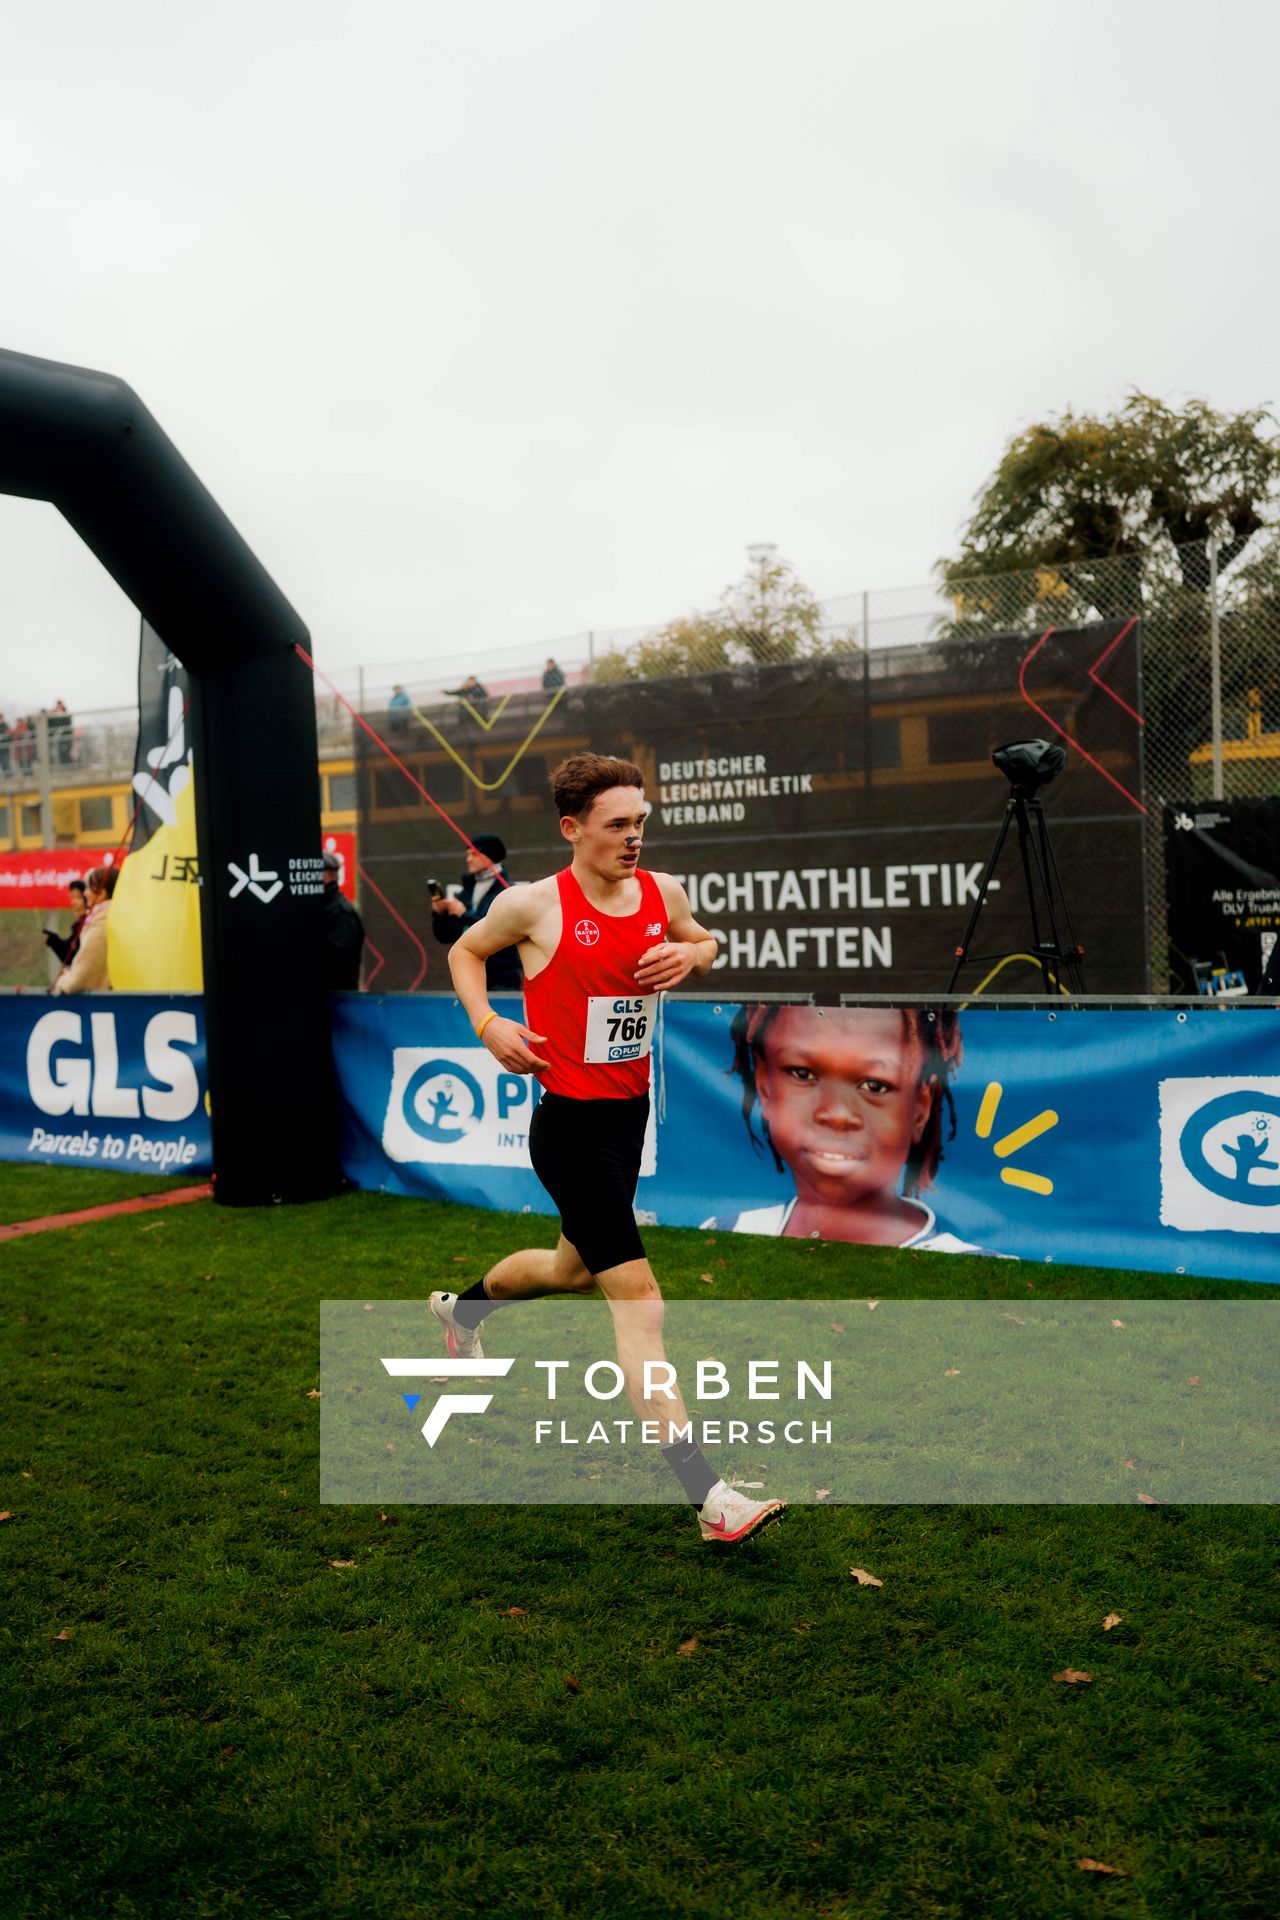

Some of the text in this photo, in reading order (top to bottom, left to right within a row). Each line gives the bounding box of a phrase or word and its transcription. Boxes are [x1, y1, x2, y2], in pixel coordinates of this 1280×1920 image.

[660, 754, 767, 781] DEUTSCHER
[660, 773, 813, 804] LEICHTATHLETIK
[661, 802, 745, 826] VERBAND
[673, 862, 1001, 913] ICHTATHLETIK-
[607, 1016, 648, 1042] 766
[622, 1046, 640, 1054] PLAN
[28, 1127, 197, 1170] Parcels to People
